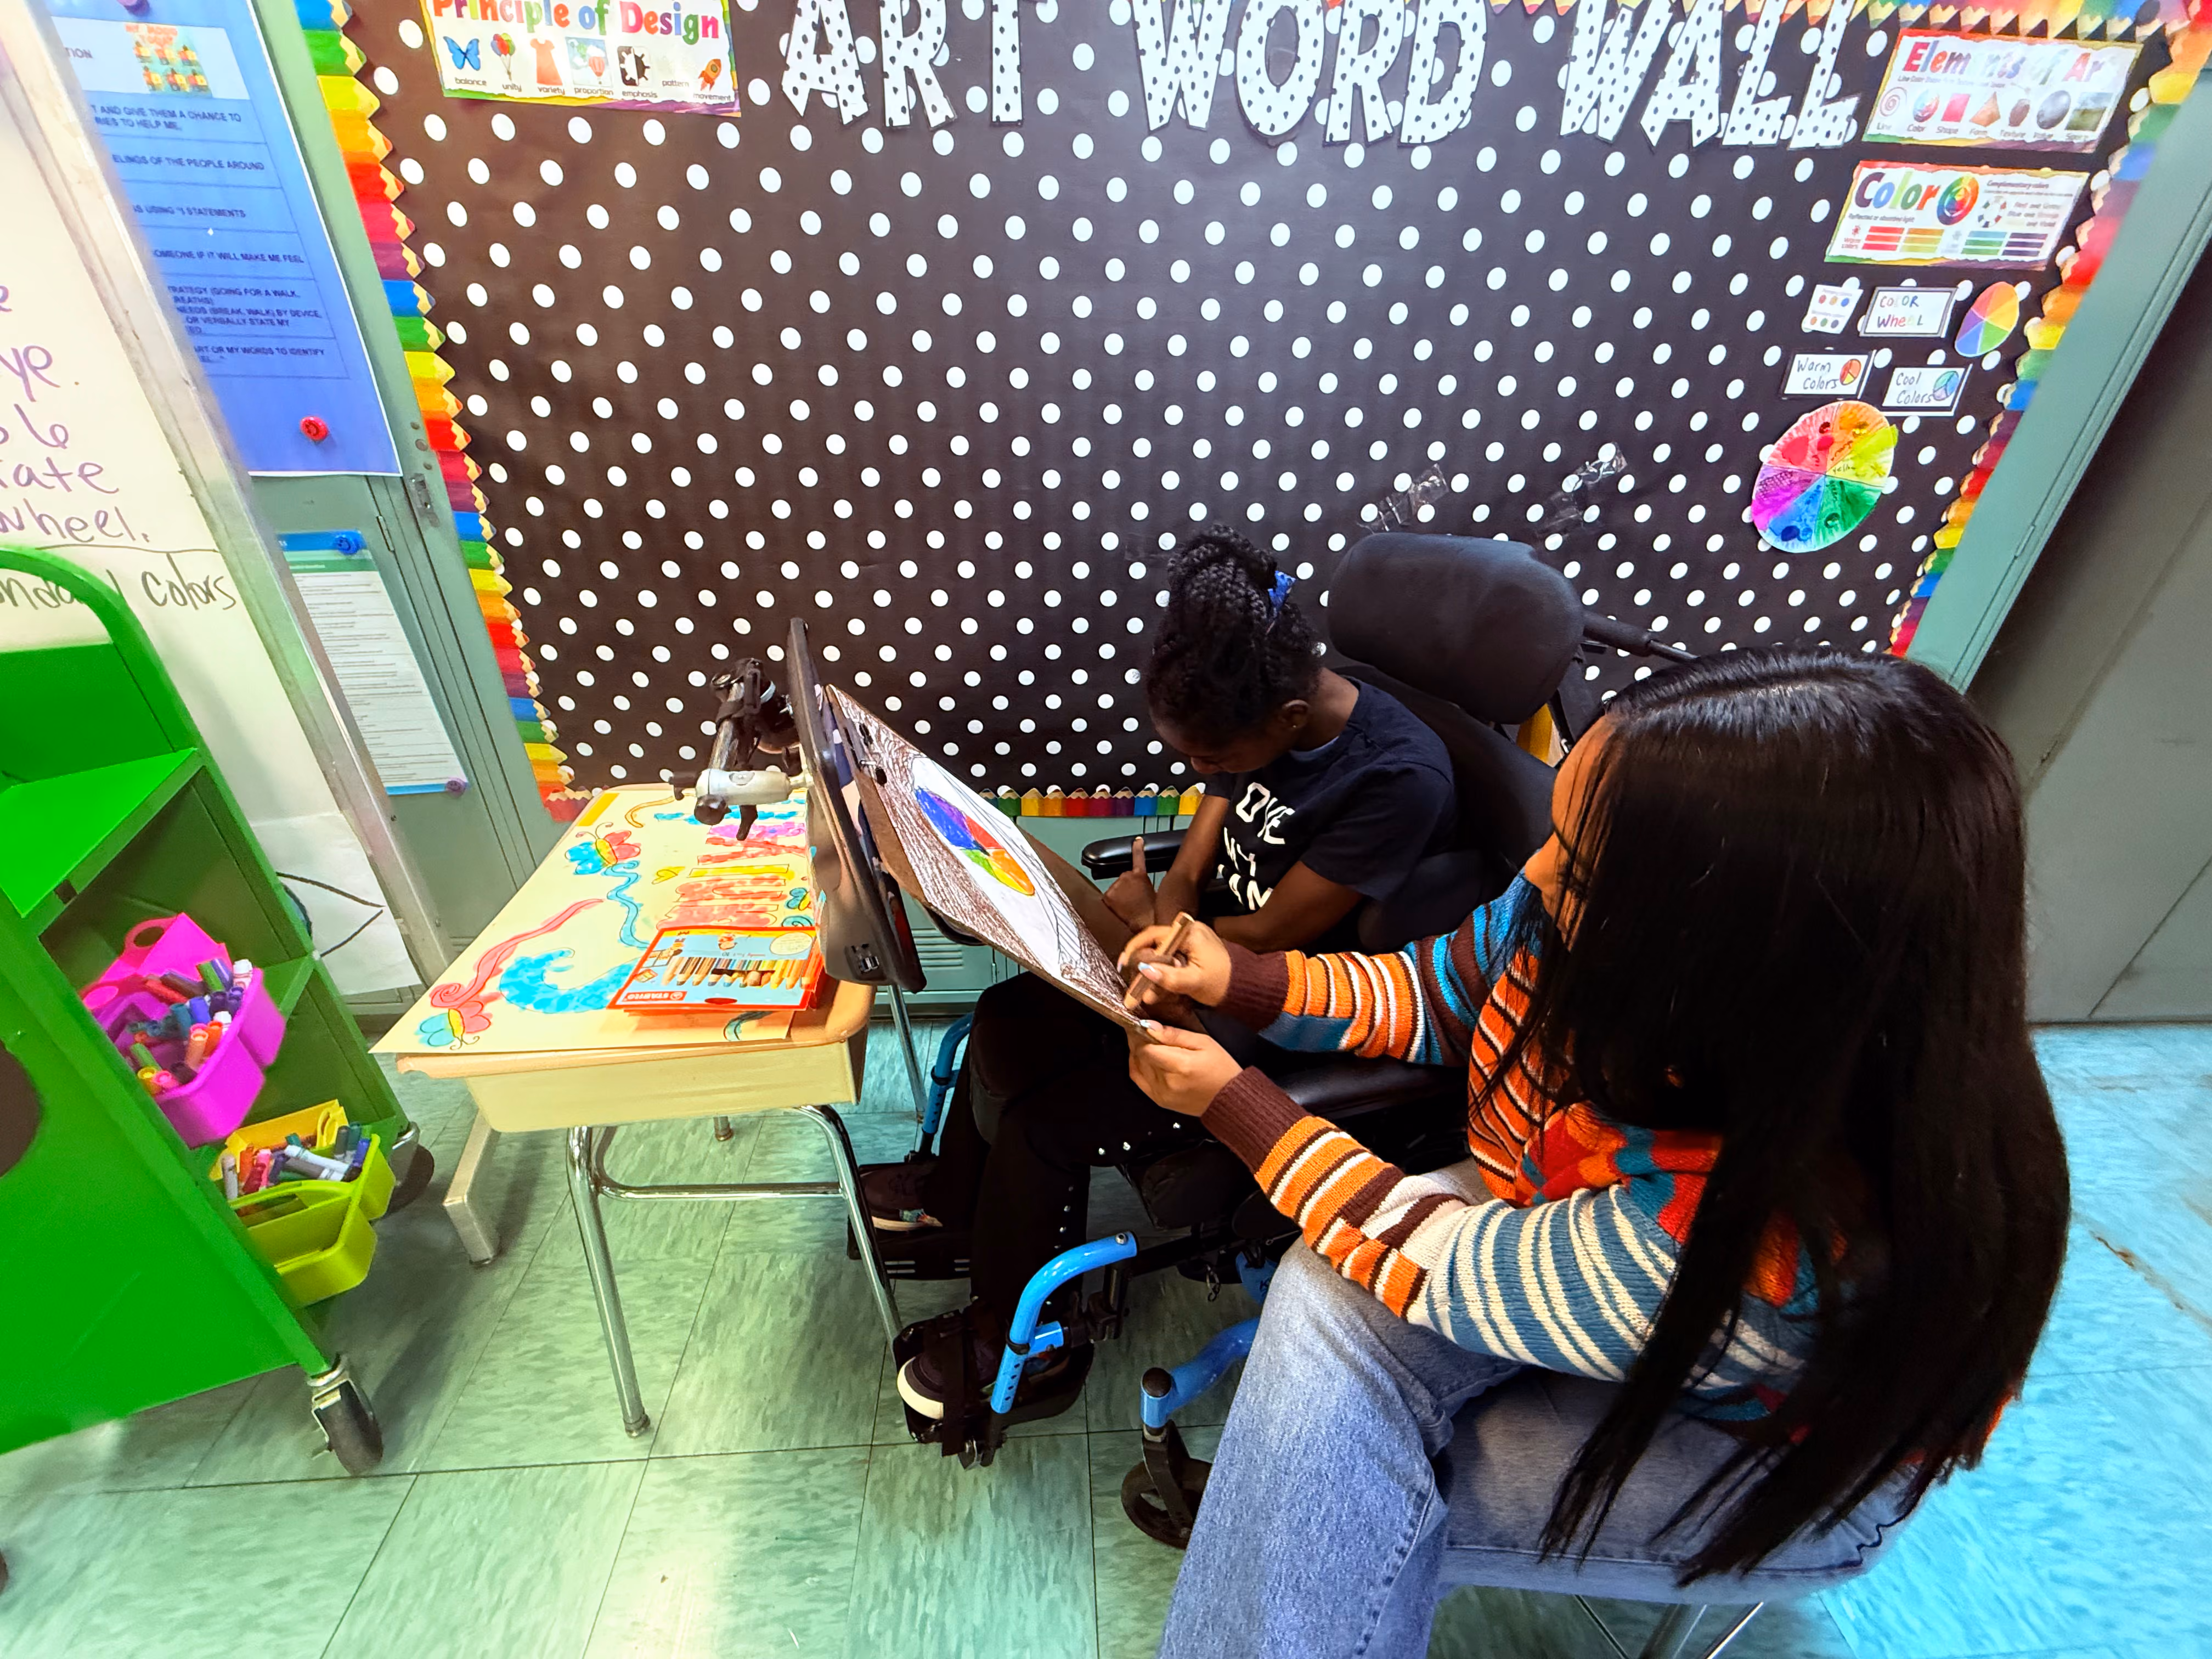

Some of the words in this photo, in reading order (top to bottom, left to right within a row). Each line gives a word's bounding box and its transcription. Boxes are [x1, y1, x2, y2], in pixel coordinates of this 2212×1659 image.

[433, 0, 571, 33] Principle
[579, 1, 609, 35] of
[620, 1, 719, 45] Design
[1133, 0, 1489, 145] WORD
[1559, 0, 1861, 149] WALL
[454, 77, 487, 87] balance
[501, 83, 522, 92] unity
[662, 80, 690, 88] pattern
[538, 86, 566, 97] variety
[574, 86, 613, 95] proportion
[622, 90, 658, 99] emphasis
[693, 92, 731, 101] movement
[100, 106, 122, 115] AND
[179, 110, 187, 119] A
[187, 111, 228, 122] CHANCE
[228, 112, 241, 123] TO
[120, 118, 134, 128] TO
[149, 156, 163, 165] OF
[165, 156, 185, 166] THE
[187, 157, 225, 169] PEOPLE
[227, 160, 265, 171] AROUND
[1854, 171, 1942, 211] Color
[186, 206, 246, 218] STATEMENTS
[196, 250, 204, 259] IF
[207, 251, 216, 259] IT
[217, 251, 240, 261] WILL
[240, 252, 267, 262] MAKE
[268, 254, 282, 263] ME
[283, 254, 304, 264] FEEL
[244, 287, 263, 296] FOR
[275, 308, 288, 317] BY
[199, 317, 247, 326] VERBALLY
[248, 317, 275, 326] STATE
[275, 318, 290, 327] MY
[240, 347, 274, 356] WORDS
[274, 347, 288, 356] TO
[289, 348, 325, 356] IDENTIFY
[1797, 359, 1831, 373] Warm
[1803, 376, 1839, 390] Colors
[1895, 372, 1922, 386] Cool
[1897, 389, 1934, 405] Colors
[141, 552, 236, 611] Colors
